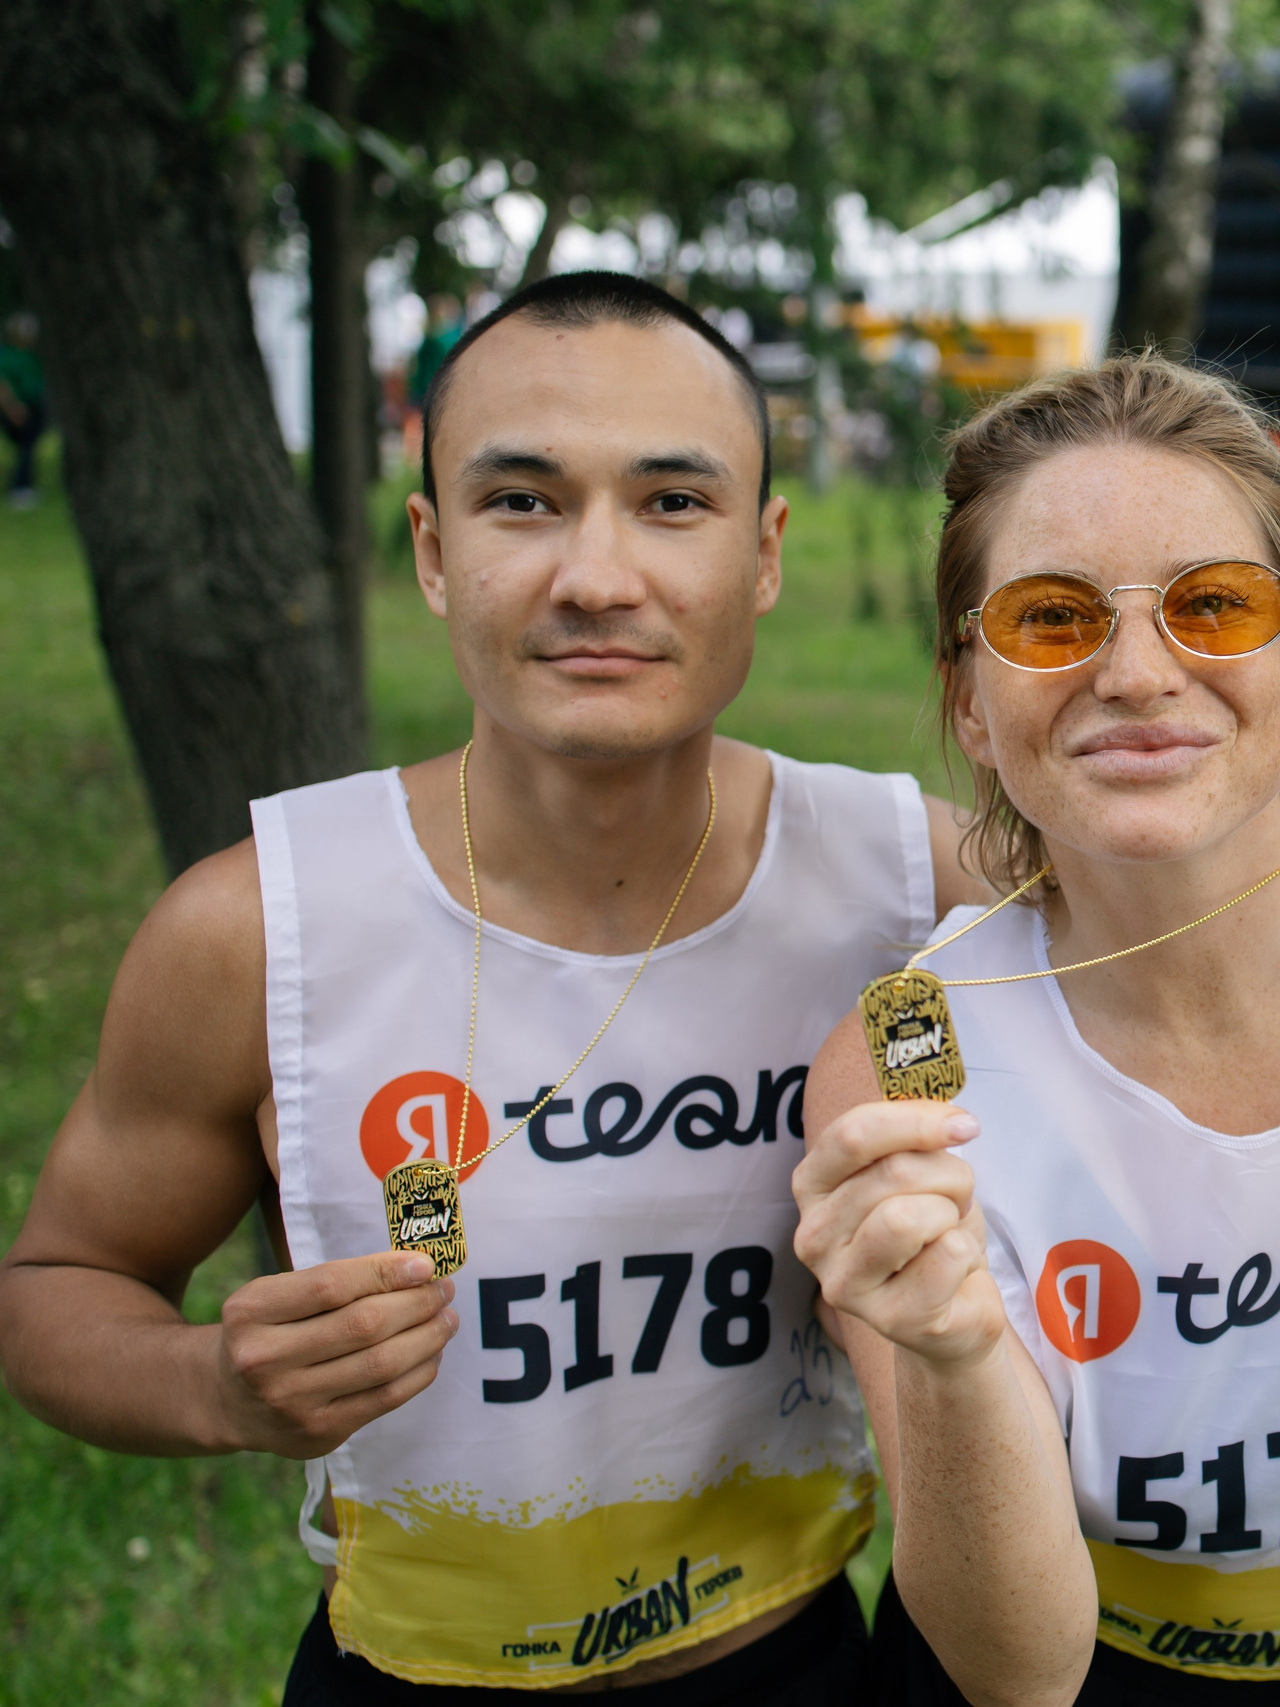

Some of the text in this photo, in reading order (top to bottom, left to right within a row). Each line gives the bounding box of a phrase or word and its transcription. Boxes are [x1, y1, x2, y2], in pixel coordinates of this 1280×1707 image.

[886, 1023, 942, 1068] URBAN
[400, 1207, 451, 1240] URBAN
[478, 1245, 773, 1404] 5178
[502, 1556, 743, 1666] ГОНКА URBAN ГЕРОЕВ
